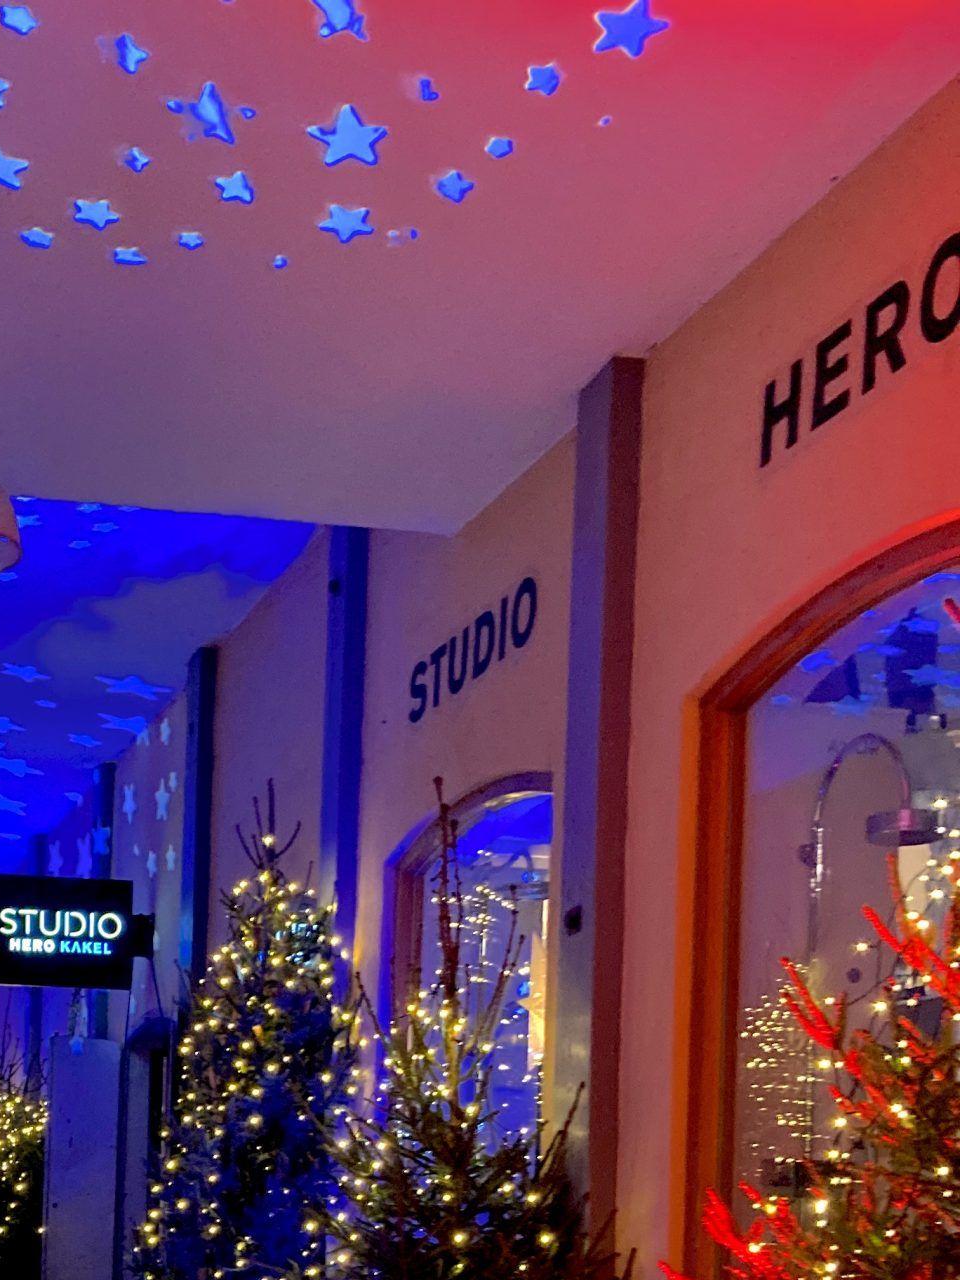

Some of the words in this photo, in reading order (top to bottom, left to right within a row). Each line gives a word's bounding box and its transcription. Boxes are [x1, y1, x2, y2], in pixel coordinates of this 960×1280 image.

[760, 231, 960, 468] HERO
[409, 577, 537, 723] STUDIO
[0, 908, 122, 939] STUDIO
[9, 938, 56, 953] HERO
[60, 941, 112, 955] KAKEL
